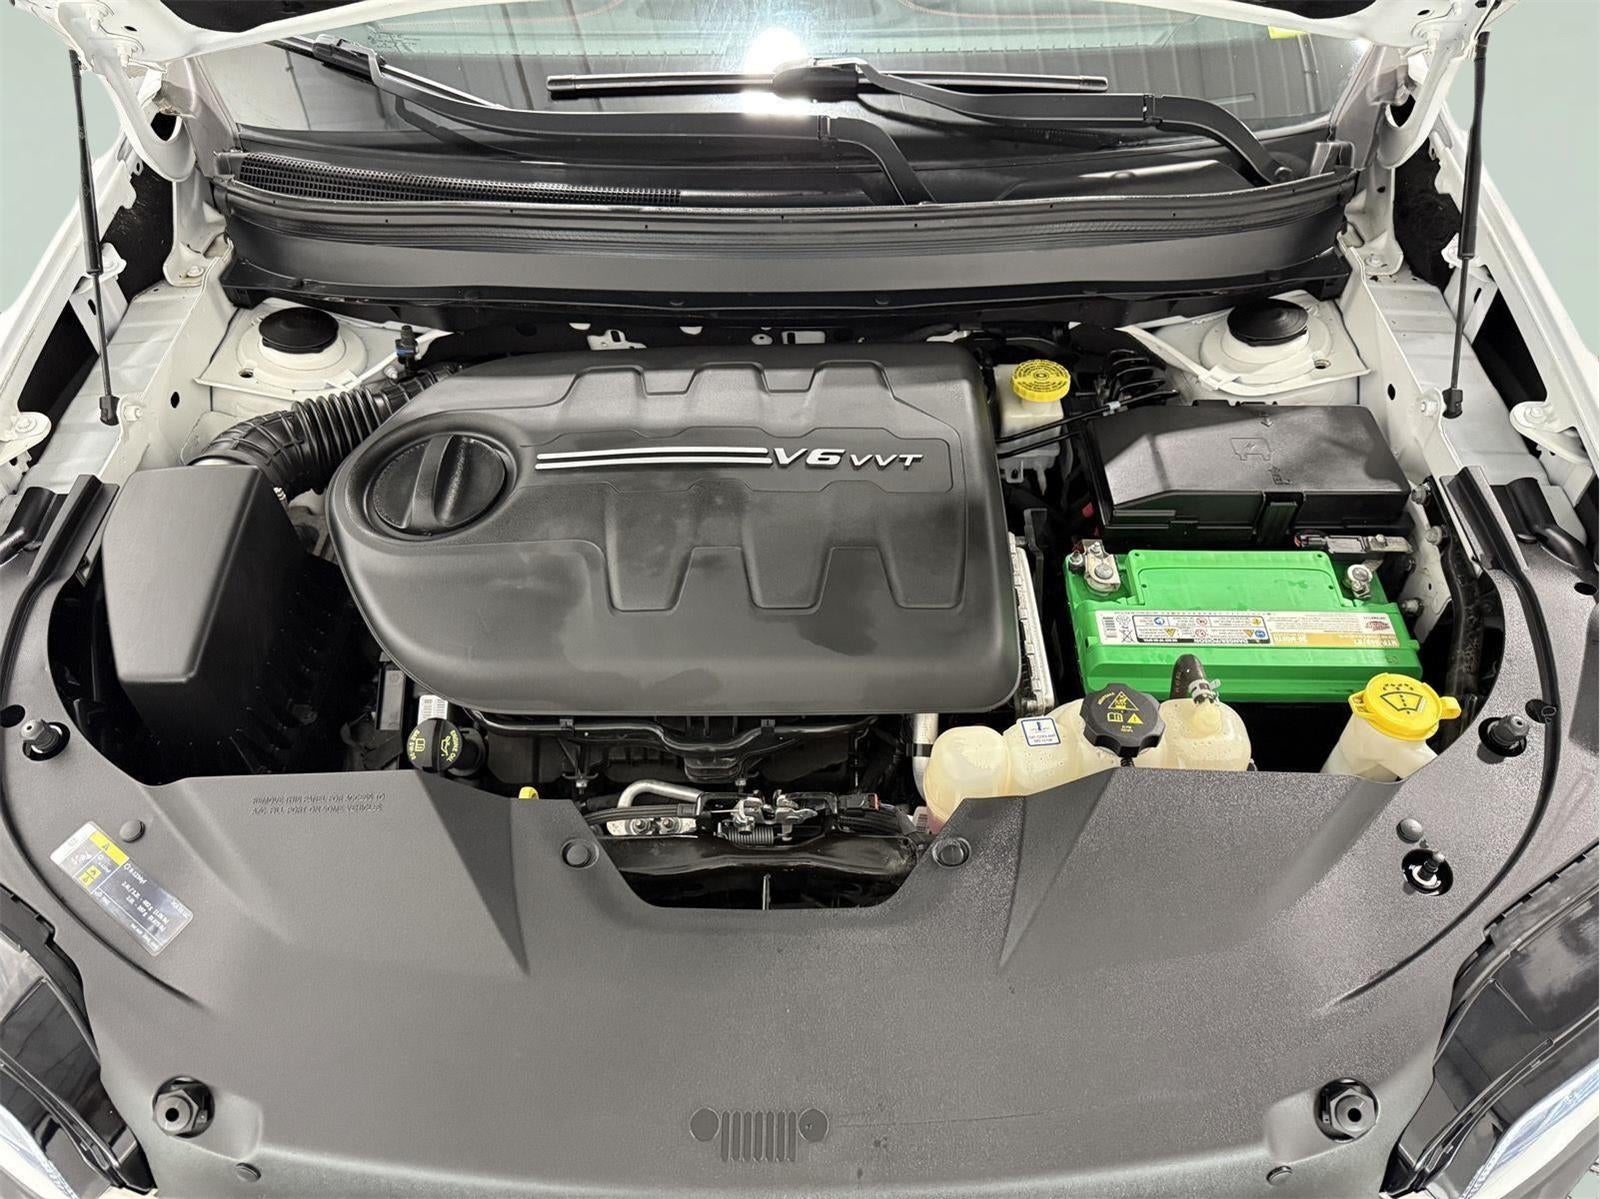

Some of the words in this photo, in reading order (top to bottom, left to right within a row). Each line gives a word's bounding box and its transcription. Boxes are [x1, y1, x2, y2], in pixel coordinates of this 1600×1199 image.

[774, 447, 847, 468] V6
[849, 453, 924, 470] VVT
[446, 752, 456, 762] OIL
